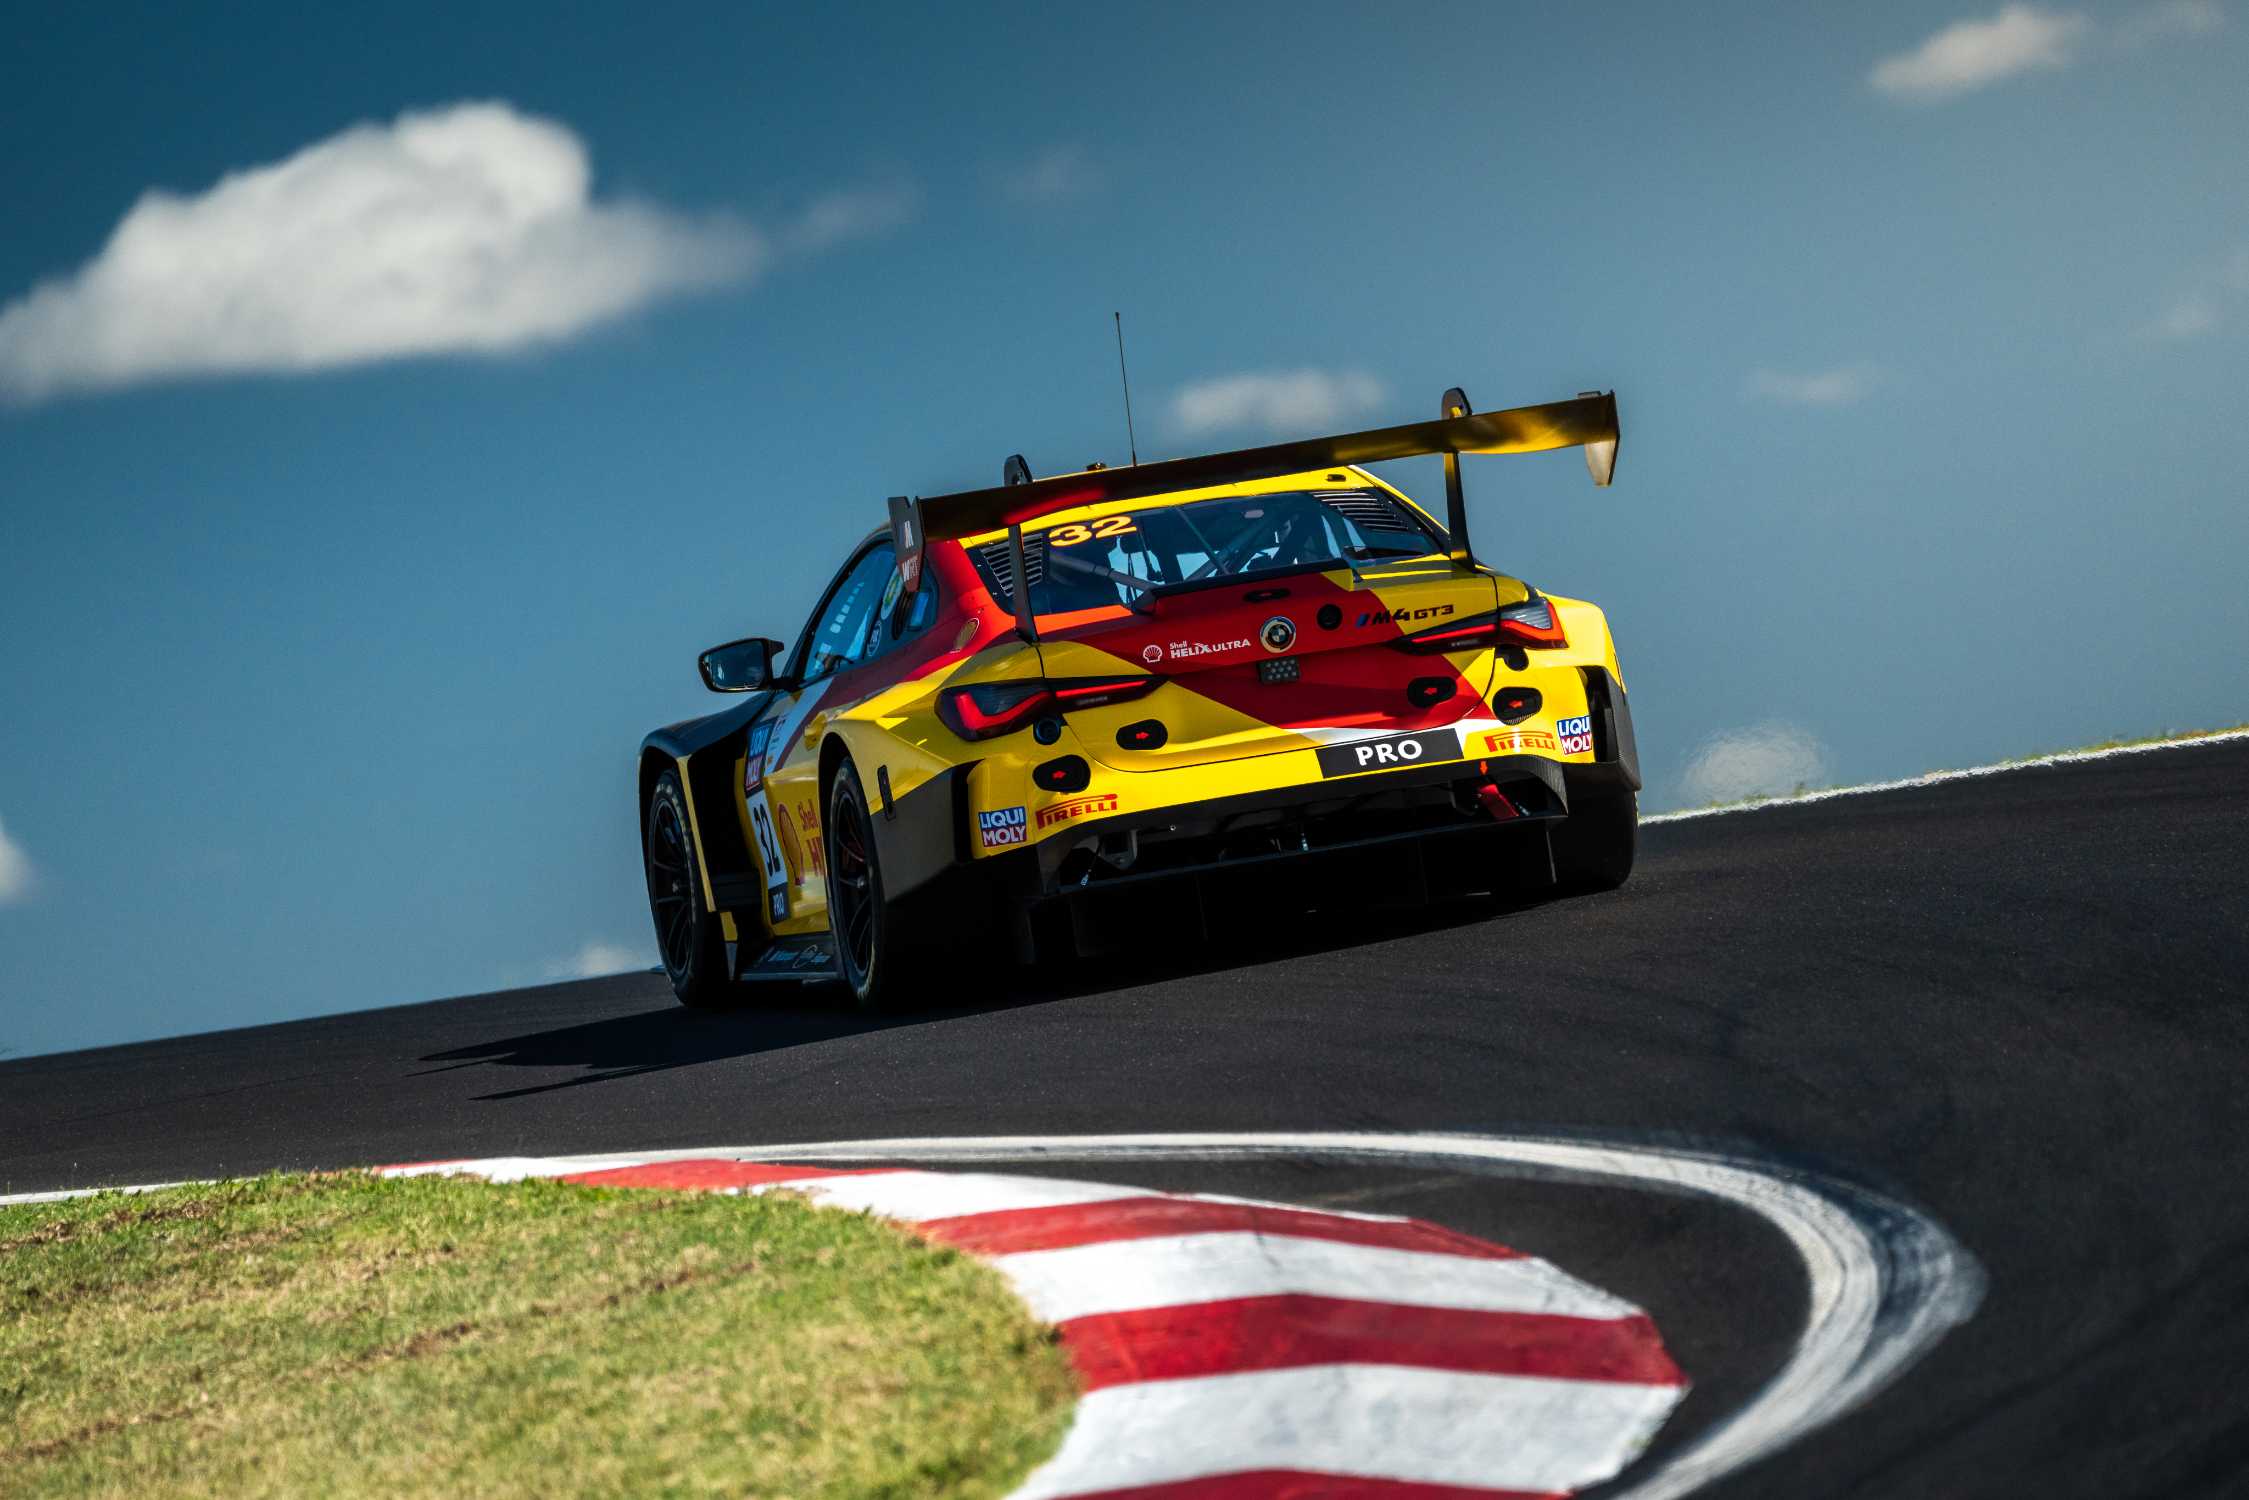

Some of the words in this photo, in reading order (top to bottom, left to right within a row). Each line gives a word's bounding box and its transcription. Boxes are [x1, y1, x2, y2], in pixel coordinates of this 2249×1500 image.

[1048, 516, 1137, 547] 32
[1371, 607, 1410, 625] M4
[1413, 604, 1455, 620] GT3
[1169, 641, 1188, 650] Shell
[1170, 642, 1212, 659] HELIX
[1212, 638, 1251, 653] ULTRA
[1558, 716, 1591, 737] LIQU
[1355, 740, 1422, 766] PRO
[980, 807, 1025, 829] LIQUI
[1035, 793, 1118, 831] PIRELLI
[982, 825, 1026, 846] MOLY
